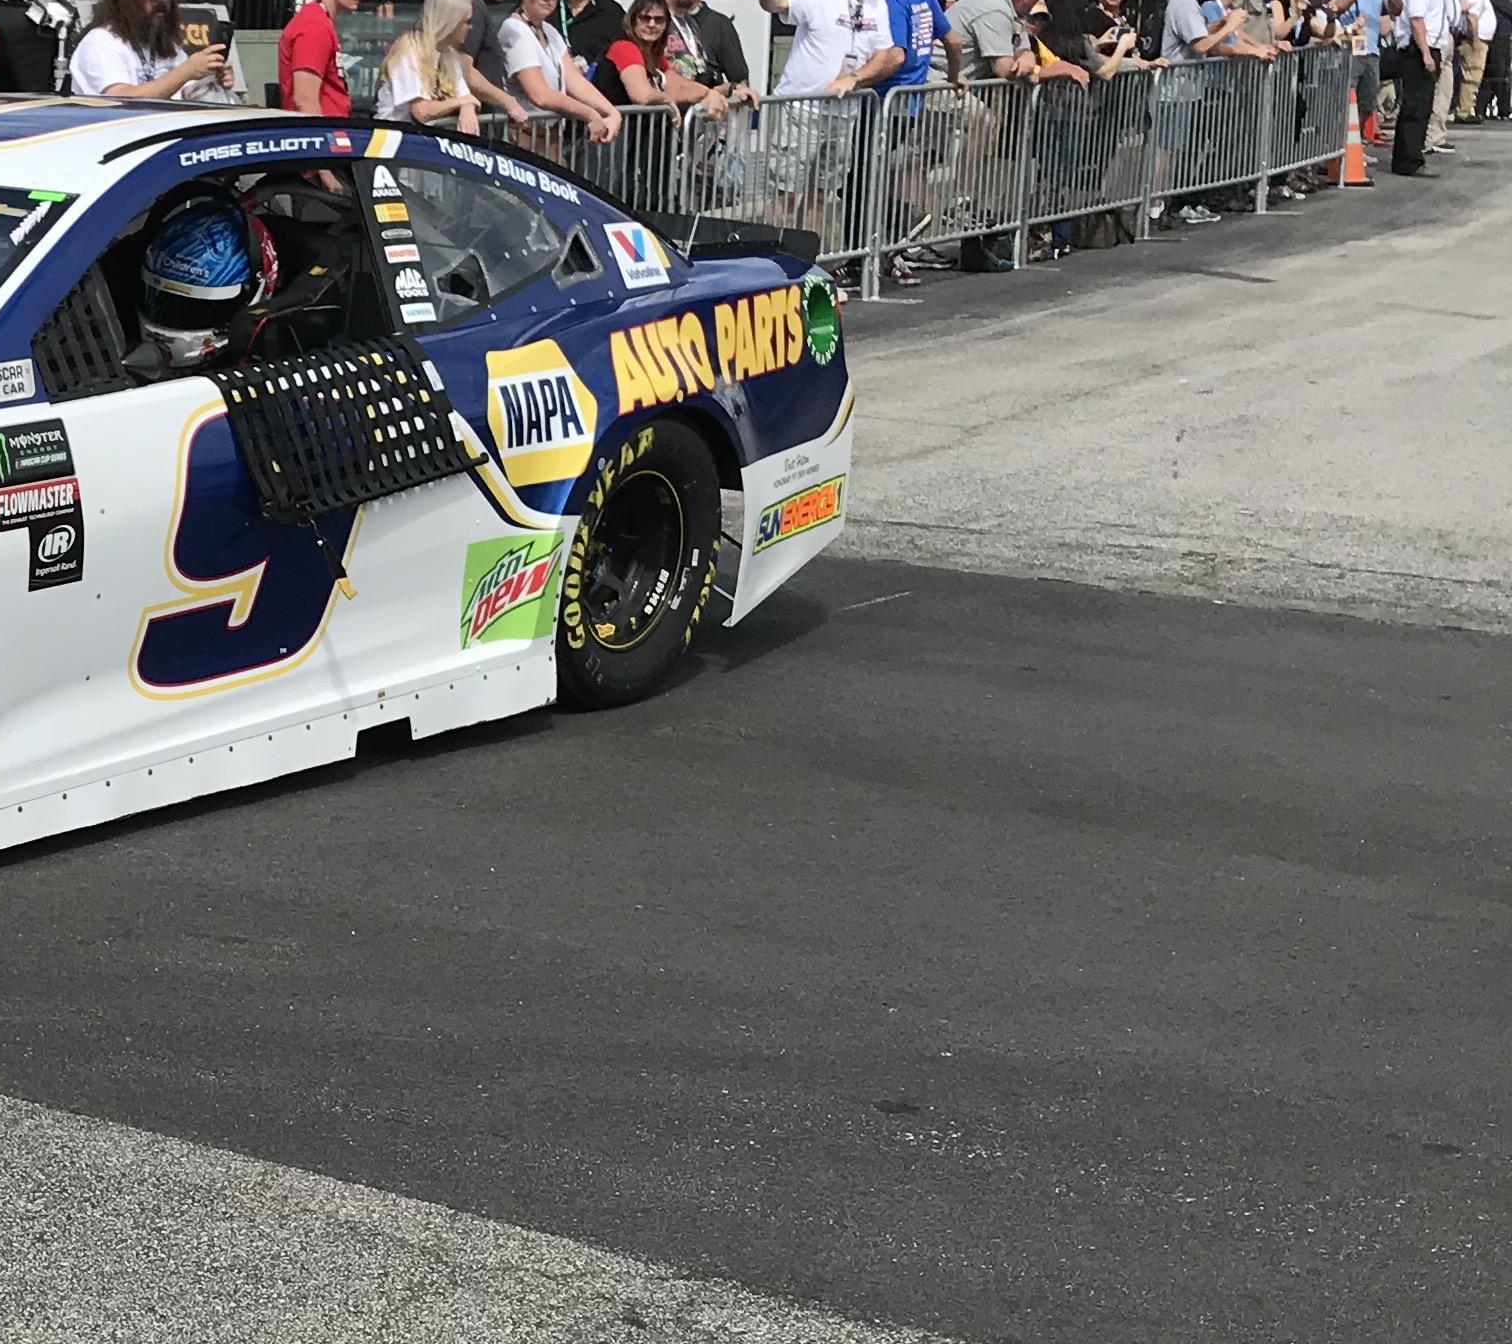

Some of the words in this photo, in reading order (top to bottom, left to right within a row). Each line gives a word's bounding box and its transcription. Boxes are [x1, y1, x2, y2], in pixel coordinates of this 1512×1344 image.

[179, 144, 242, 167] CHASE
[246, 136, 324, 155] ELLIOTT
[435, 136, 494, 175] Kelley
[495, 155, 536, 187] Blue
[538, 171, 581, 205] Book
[395, 267, 428, 291] MAC
[626, 265, 662, 281] Valvoline
[396, 288, 430, 299] TOOLS
[610, 311, 716, 417] AUTO
[714, 283, 804, 387] PARTS
[3, 382, 25, 395] CAR
[499, 375, 585, 449] NAPA
[43, 531, 70, 557] IR
